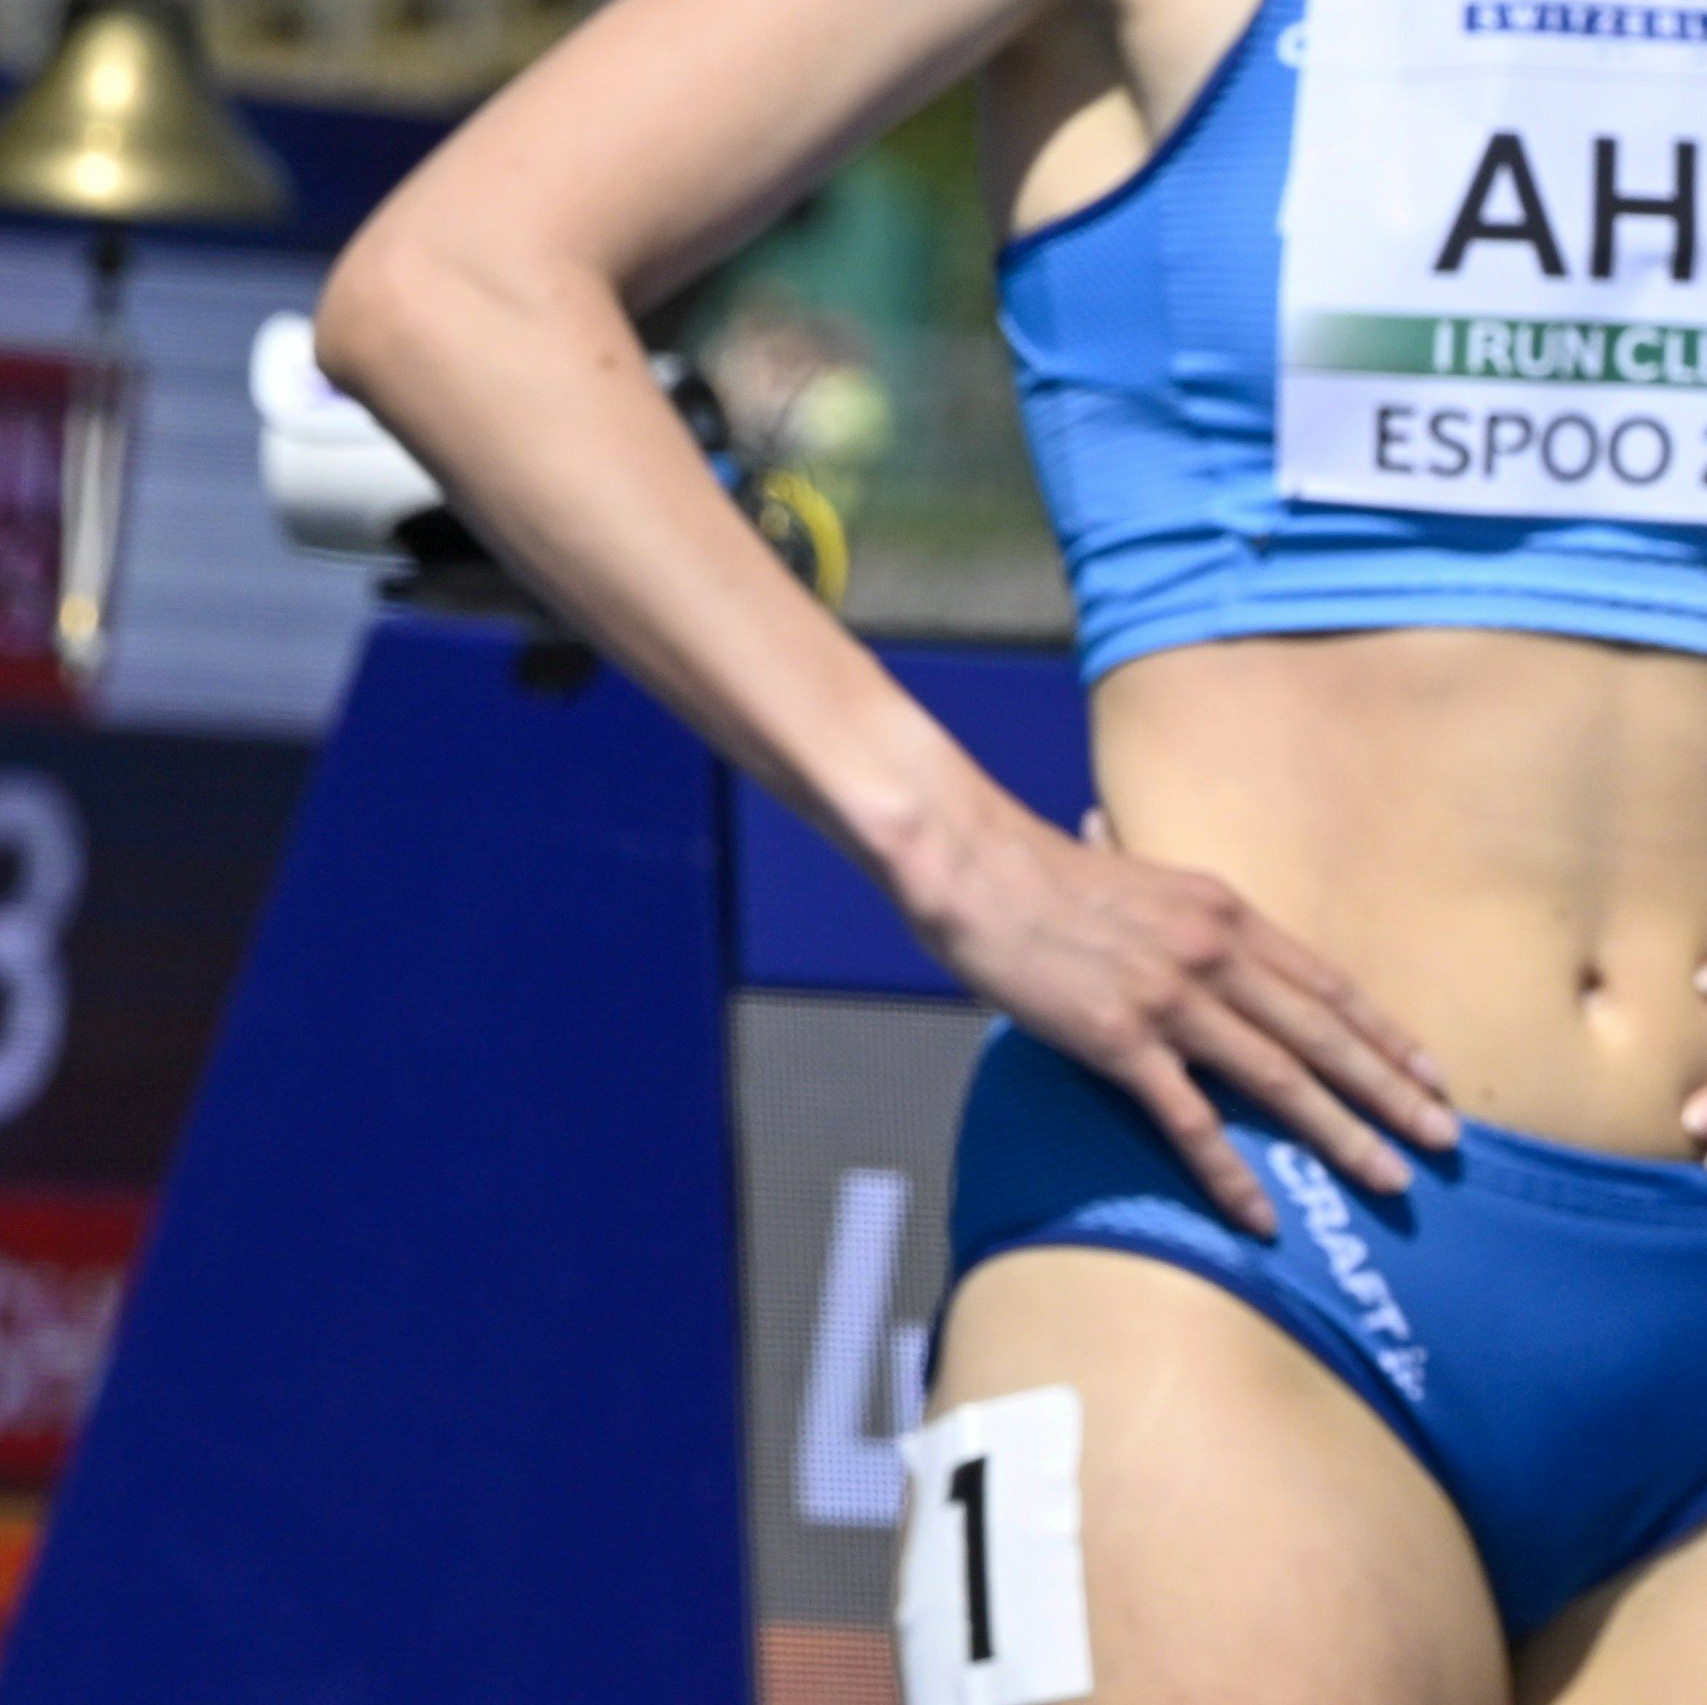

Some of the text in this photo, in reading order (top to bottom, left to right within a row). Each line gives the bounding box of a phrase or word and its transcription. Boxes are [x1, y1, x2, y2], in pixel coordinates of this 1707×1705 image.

[1432, 320, 1454, 373] I
[1465, 320, 1604, 378] RUN
[1374, 405, 1674, 486] ESPOO
[946, 1455, 995, 1664] 1
